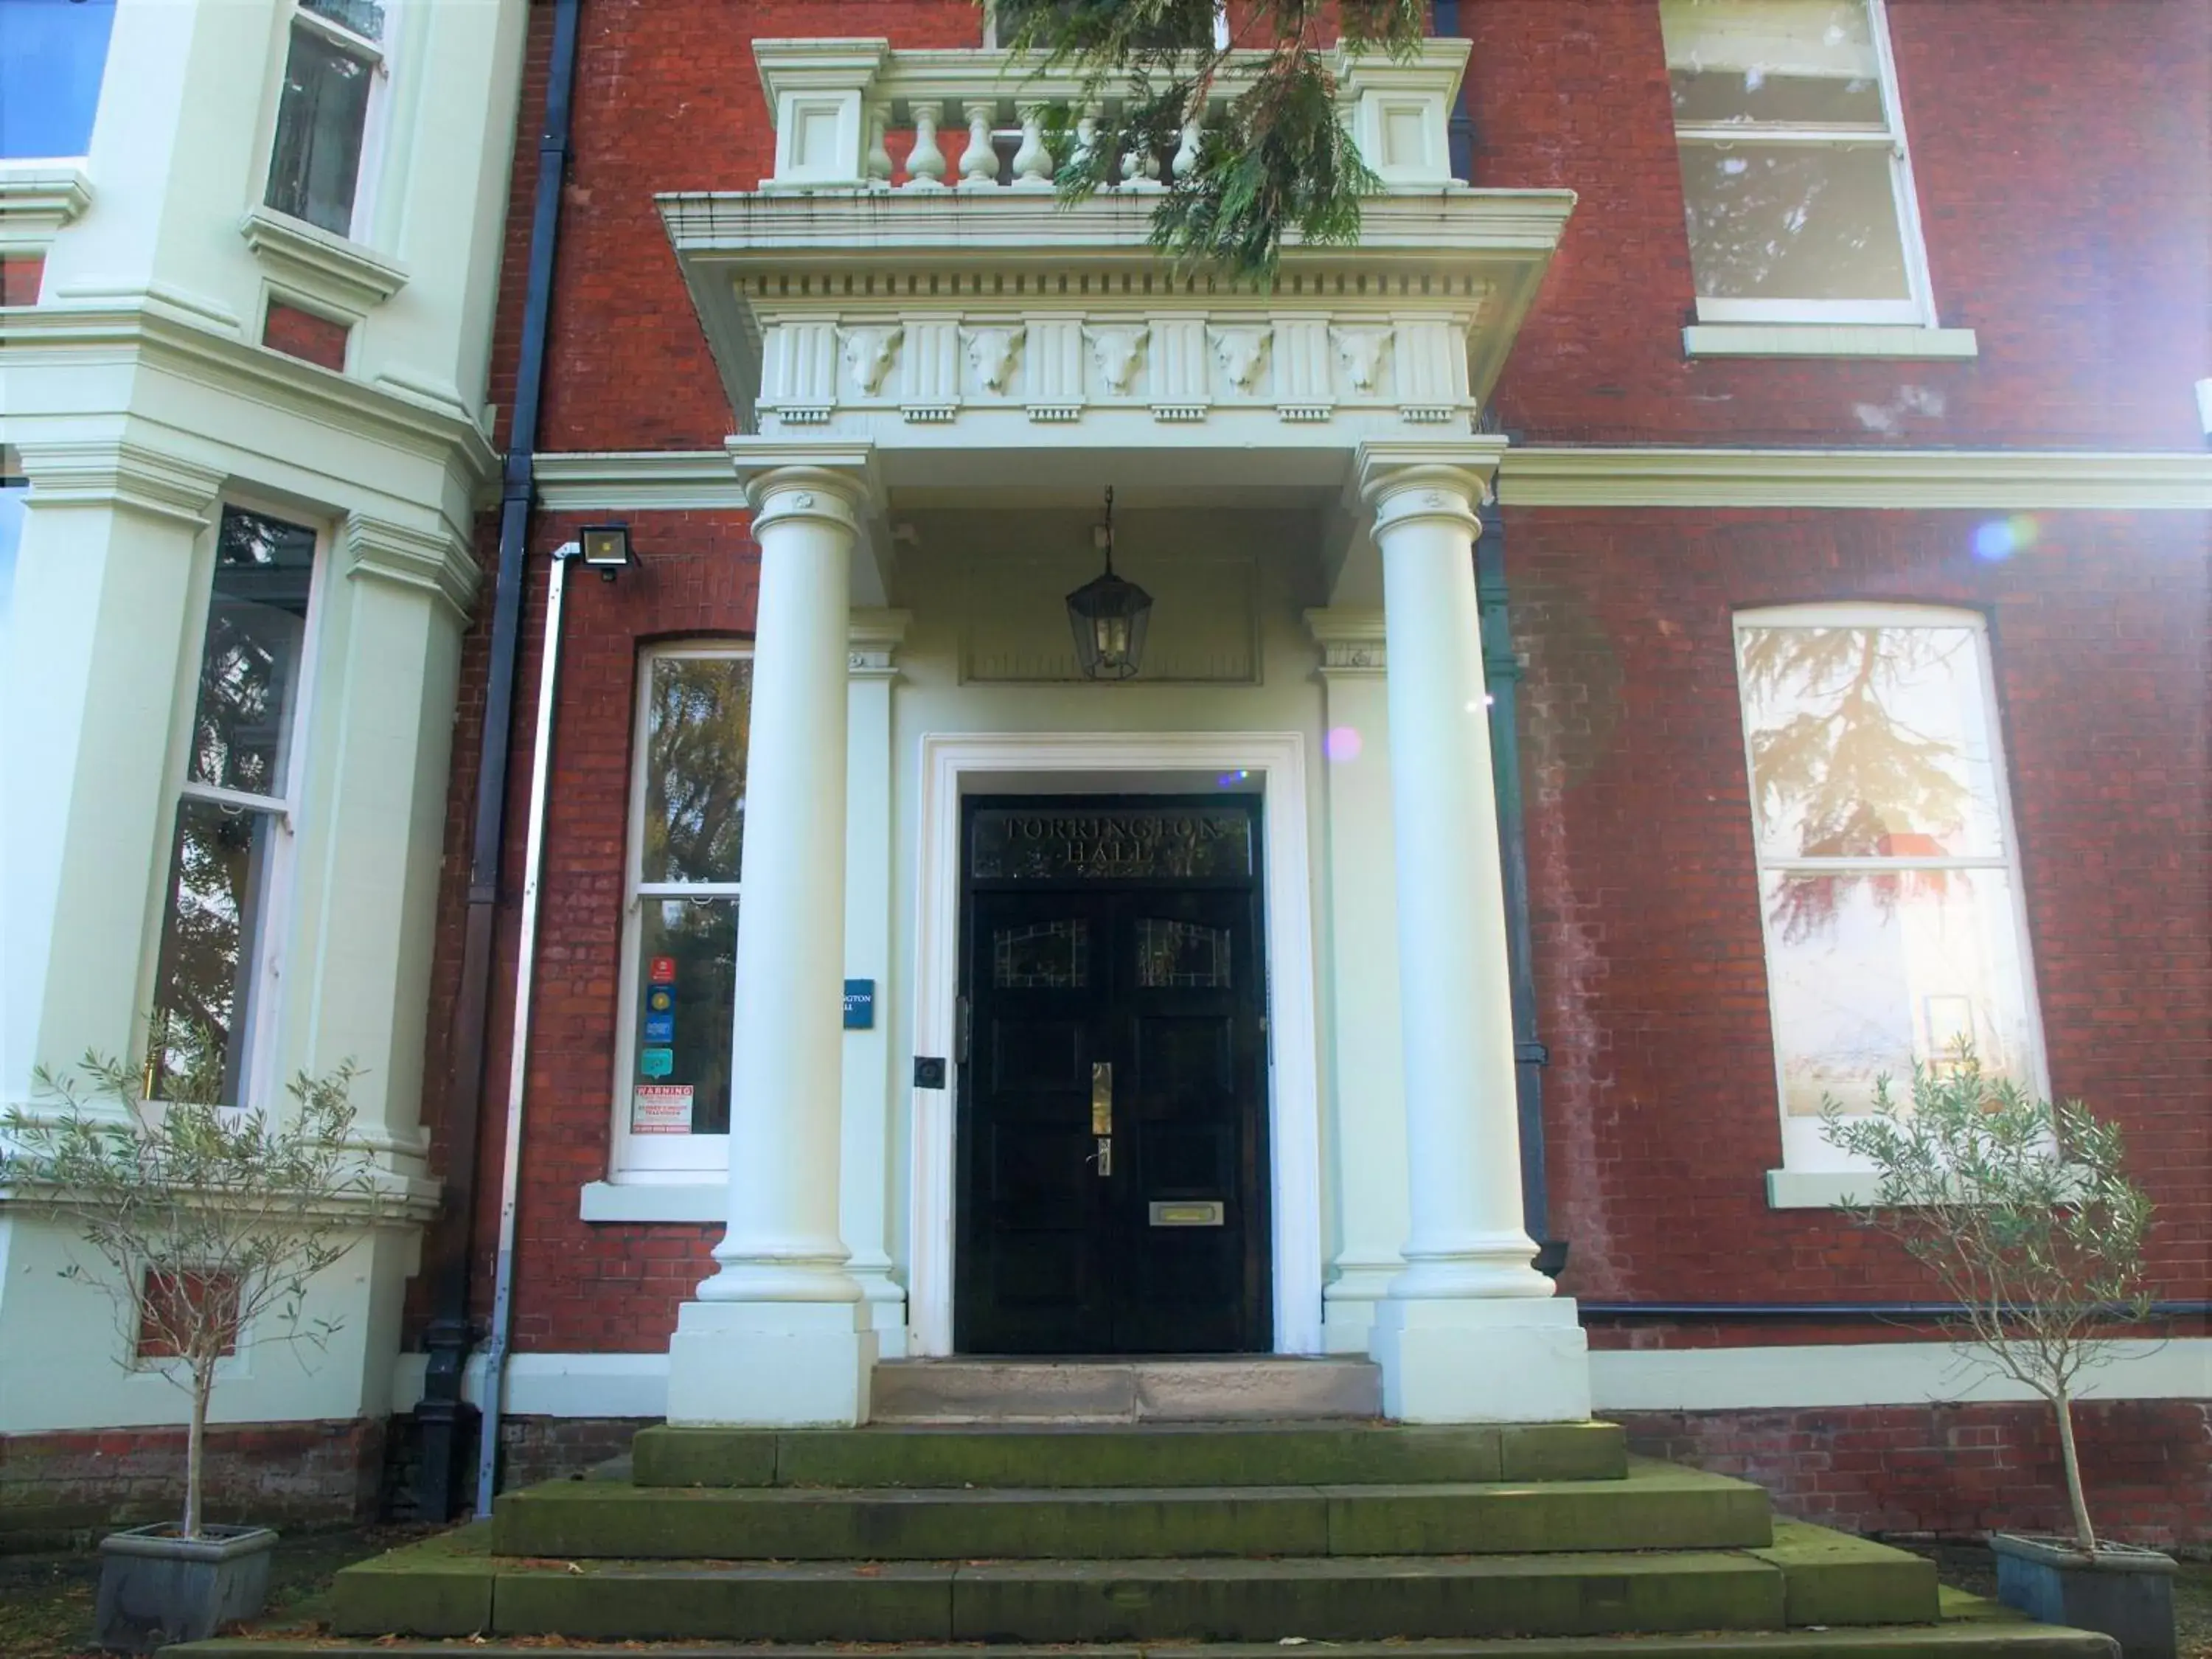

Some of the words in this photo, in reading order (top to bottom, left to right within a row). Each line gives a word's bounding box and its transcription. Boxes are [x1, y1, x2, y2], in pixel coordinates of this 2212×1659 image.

[1003, 816, 1220, 840] TORRINGTON
[1067, 841, 1154, 863] HALL
[637, 1087, 692, 1096] WARNING
